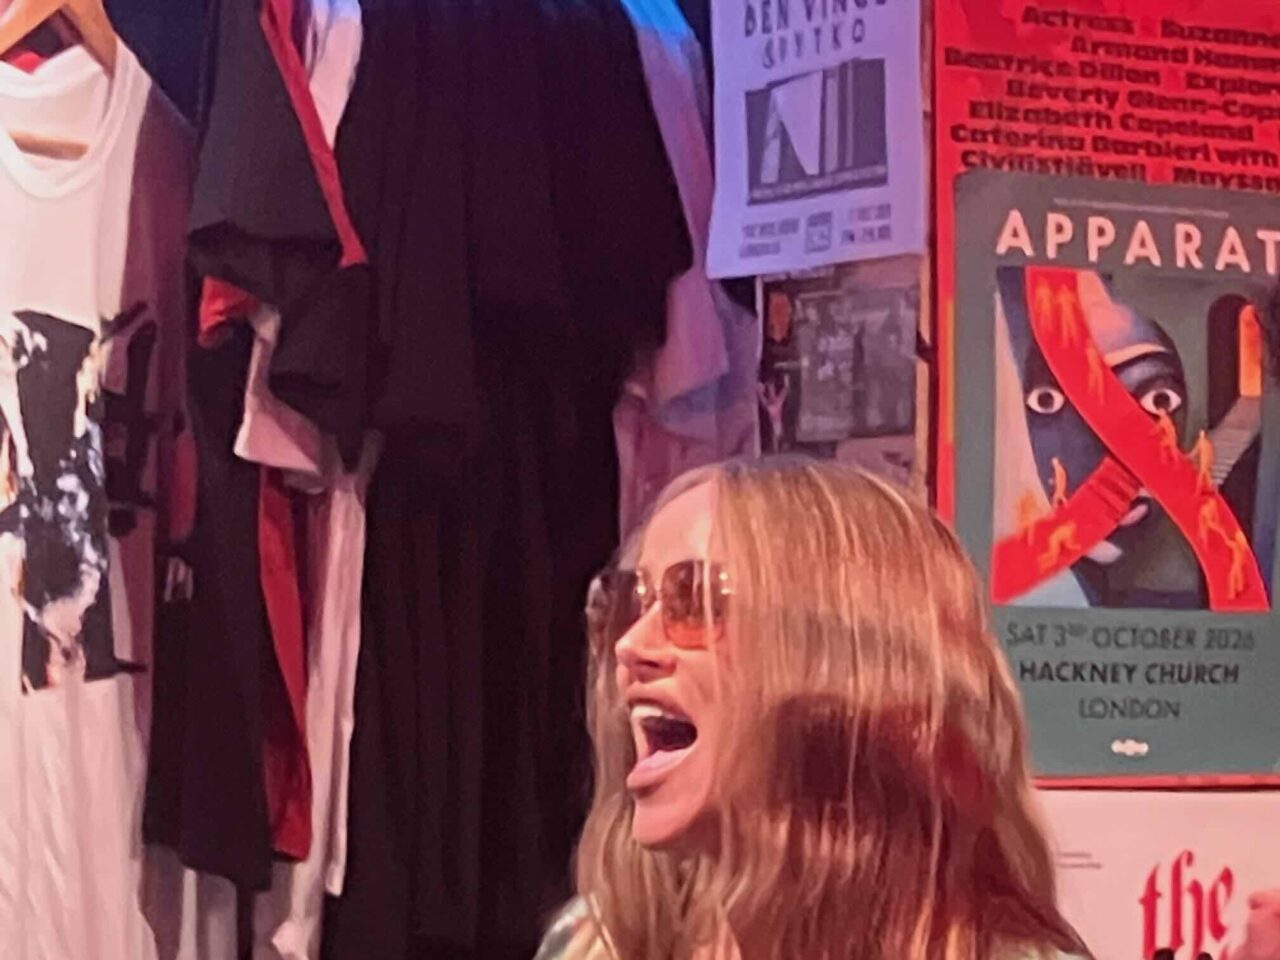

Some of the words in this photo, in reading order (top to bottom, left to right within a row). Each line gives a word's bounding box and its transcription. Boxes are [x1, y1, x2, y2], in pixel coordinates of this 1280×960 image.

[1071, 35, 1190, 64] Armand
[1079, 60, 1161, 85] Dillon
[1006, 79, 1120, 109] Beverly
[969, 99, 1113, 129] Elizabeth
[1119, 113, 1254, 142] Copeland
[950, 123, 1086, 151] Caterina
[1092, 135, 1210, 162] Barbieri
[1214, 147, 1279, 169] with
[1005, 620, 1048, 647] SAT
[1092, 625, 1197, 651] OCTOBER
[1018, 661, 1138, 685] HACKNEY
[1144, 662, 1241, 685] CHURCH
[1078, 696, 1182, 720] LONDON
